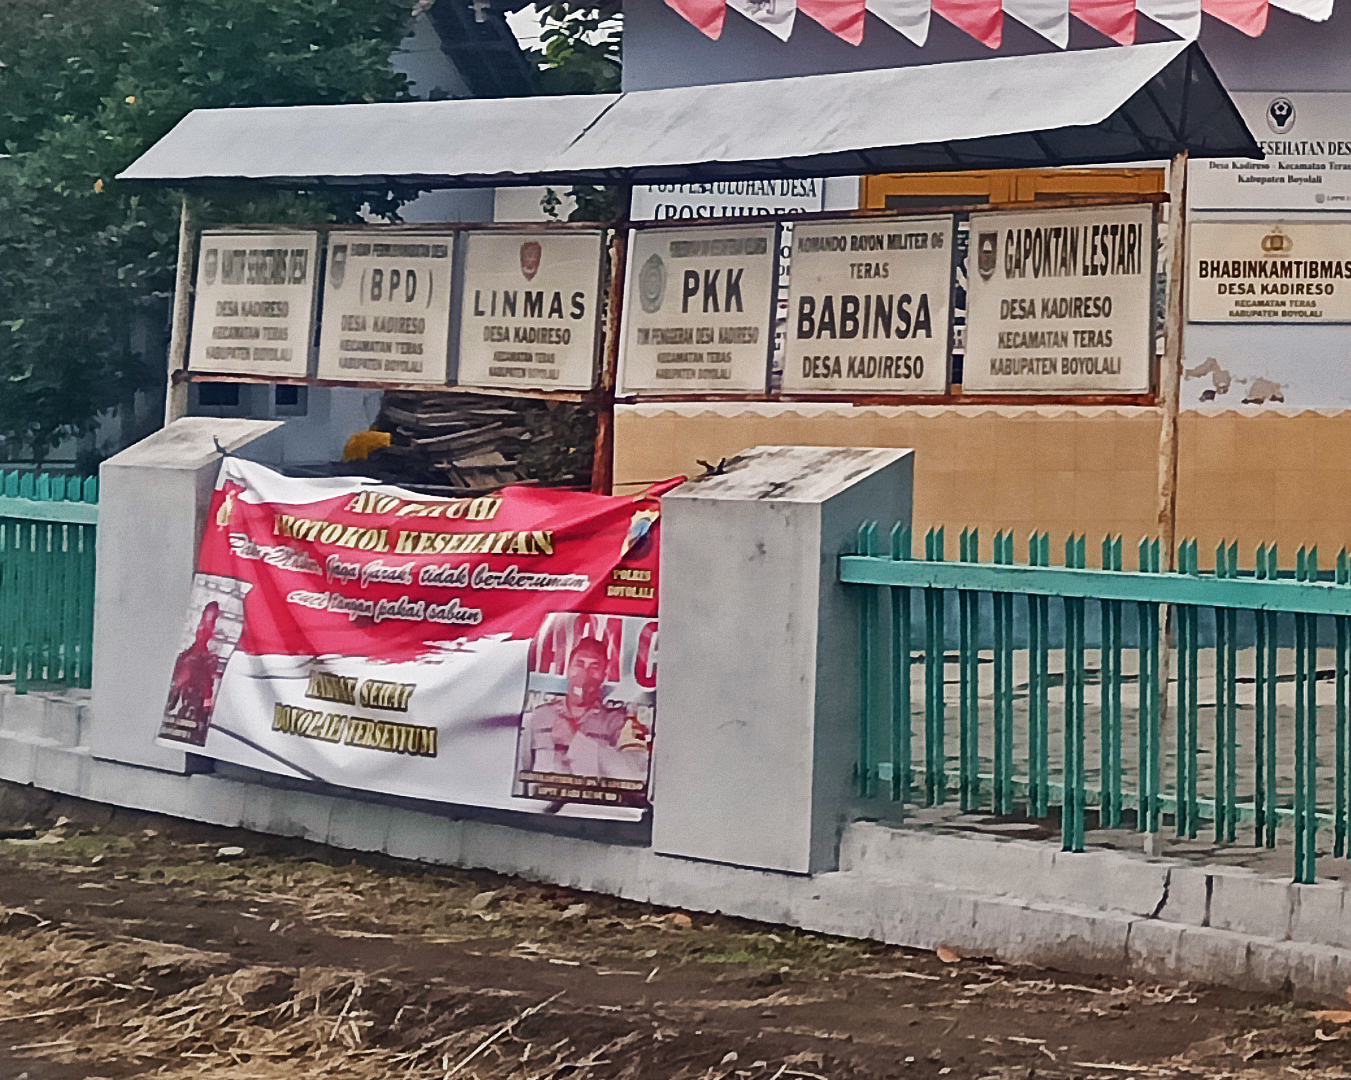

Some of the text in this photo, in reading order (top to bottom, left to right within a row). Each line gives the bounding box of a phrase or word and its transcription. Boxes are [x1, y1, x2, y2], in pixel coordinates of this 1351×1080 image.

[1260, 141, 1324, 156] ESEHATAN
[1209, 161, 1229, 170] Desa
[1278, 161, 1326, 170] Kecamatan
[780, 179, 817, 197] DESA
[1238, 174, 1285, 185] Kabupaten
[798, 236, 847, 252] KOMANDO
[850, 234, 884, 251] RAYON
[887, 233, 928, 250] MILITER
[1004, 223, 1142, 279] GAPOKTAN LESTARI
[850, 262, 889, 279] TERAS
[682, 268, 744, 313] PKK
[1217, 283, 1335, 295] DESA KADIRESO
[473, 290, 586, 320] LINMAS
[1000, 296, 1112, 320] DESA KADIRESO
[797, 294, 932, 339] BABINSA
[483, 325, 571, 345] DESA KADIRESO
[998, 330, 1113, 349] KECAMATAN TERAS
[802, 355, 924, 379] DESA KADIRESO
[990, 357, 1121, 376] KABUPATEN BOYOLALI
[344, 491, 401, 514] AYO
[394, 530, 554, 555] KESEHATAN
[419, 563, 470, 588] tidak
[374, 596, 426, 623] pakai
[426, 598, 482, 624] sabun
